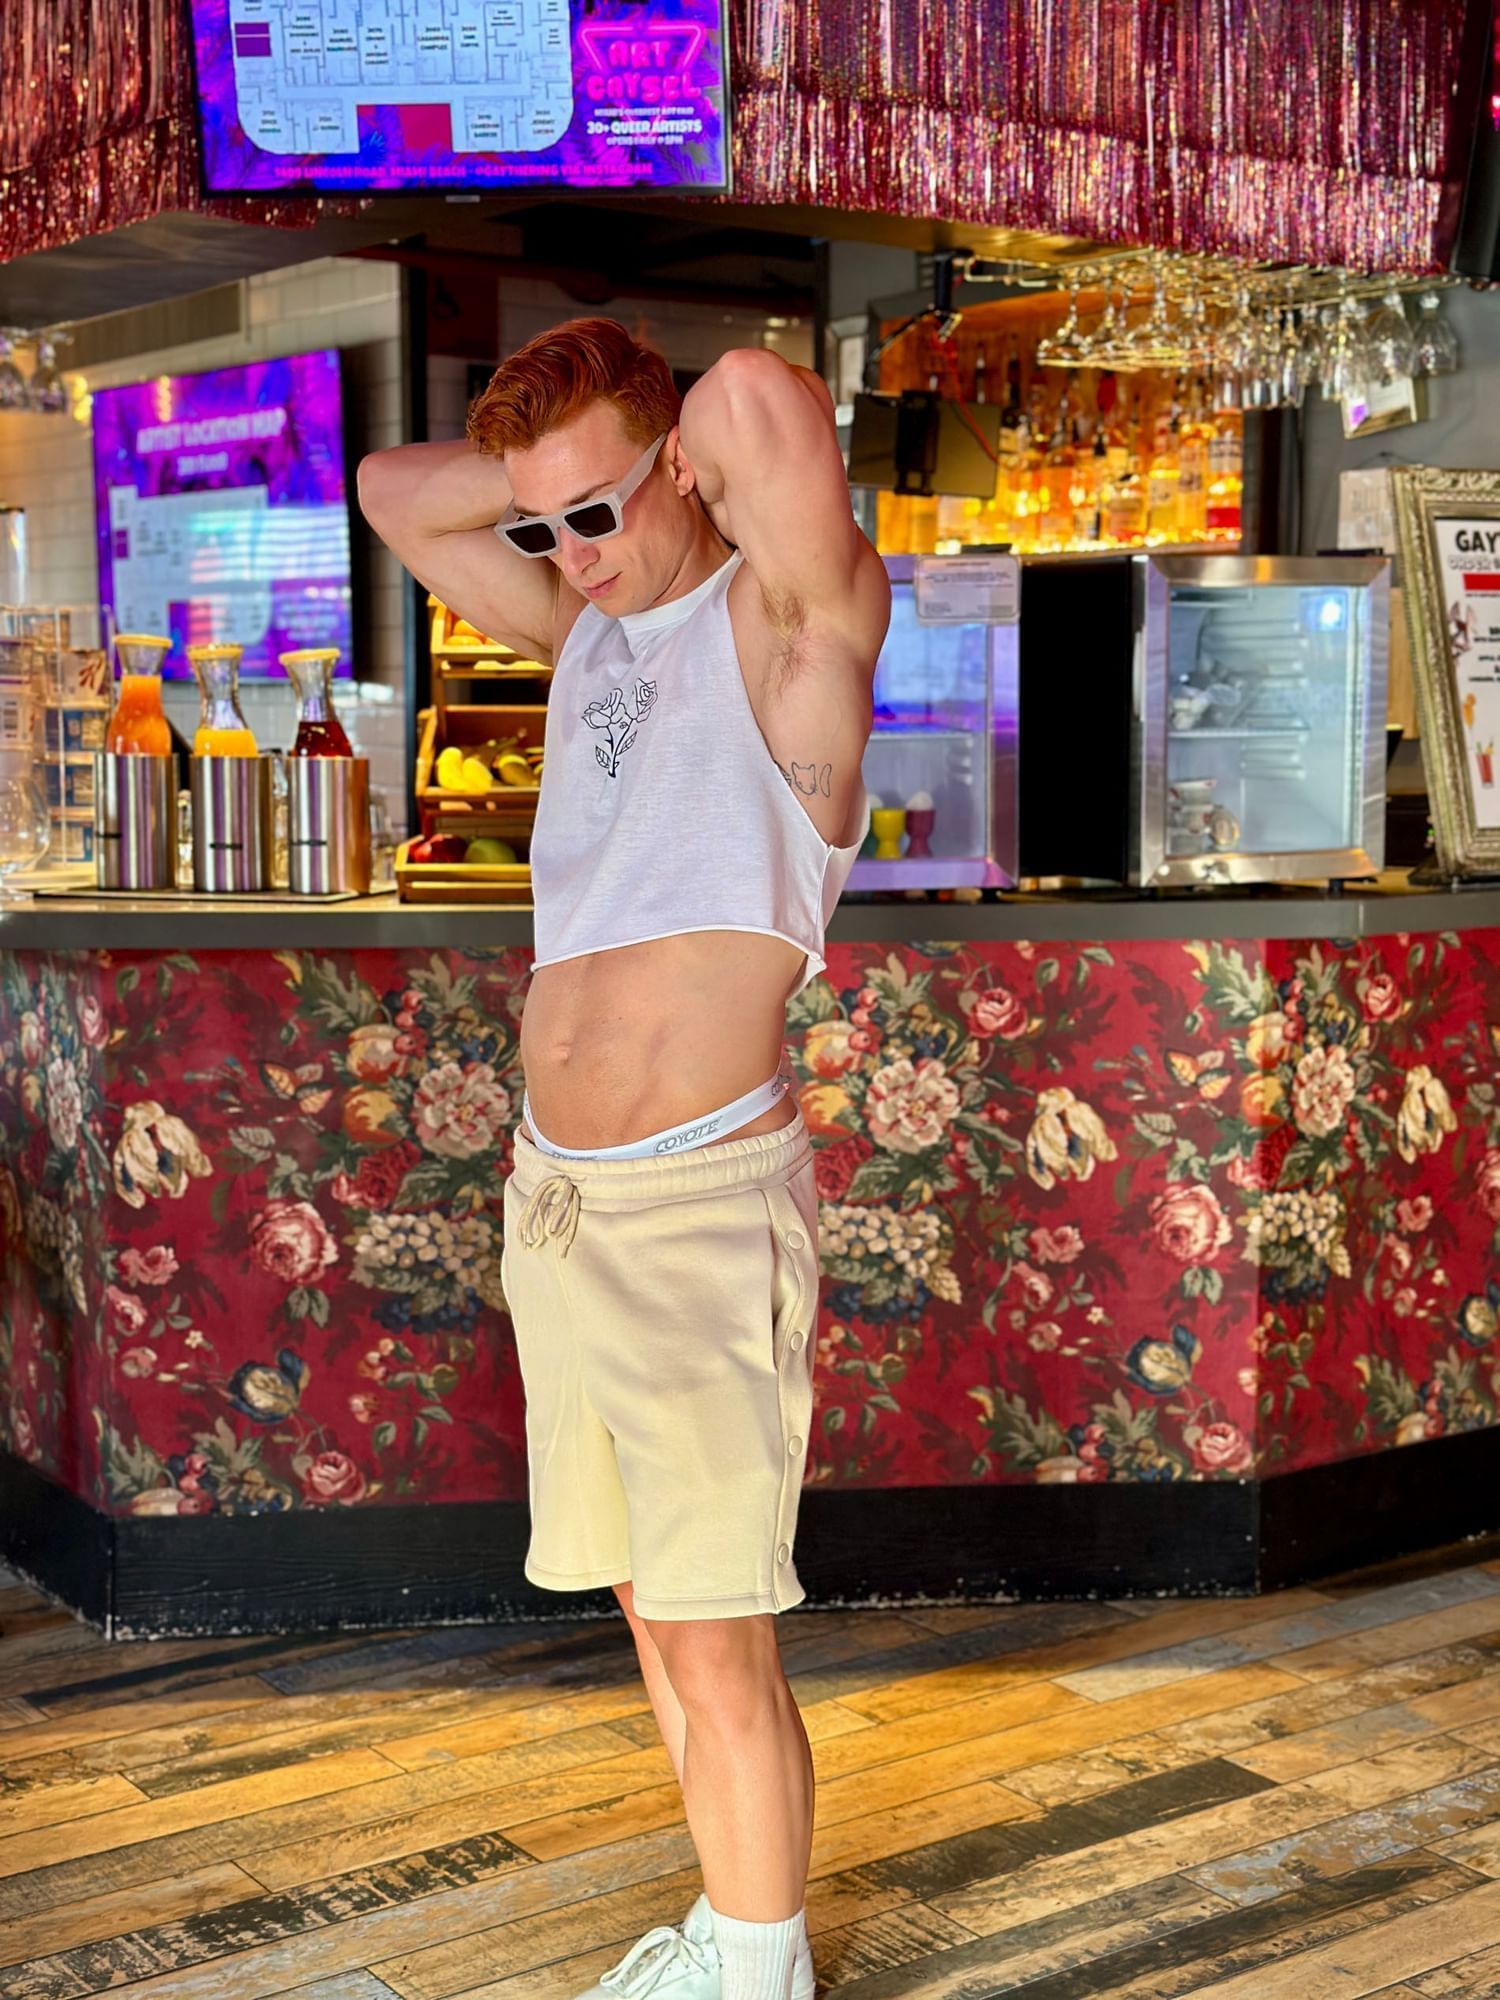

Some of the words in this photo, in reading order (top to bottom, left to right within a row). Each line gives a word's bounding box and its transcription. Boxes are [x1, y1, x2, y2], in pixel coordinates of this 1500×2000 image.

[608, 40, 671, 68] ART
[586, 121, 610, 135] 30+
[611, 119, 650, 135] QUEER
[651, 118, 702, 134] ARTISTS
[1456, 529, 1500, 554] GAY
[655, 1118, 720, 1153] COYOTE
